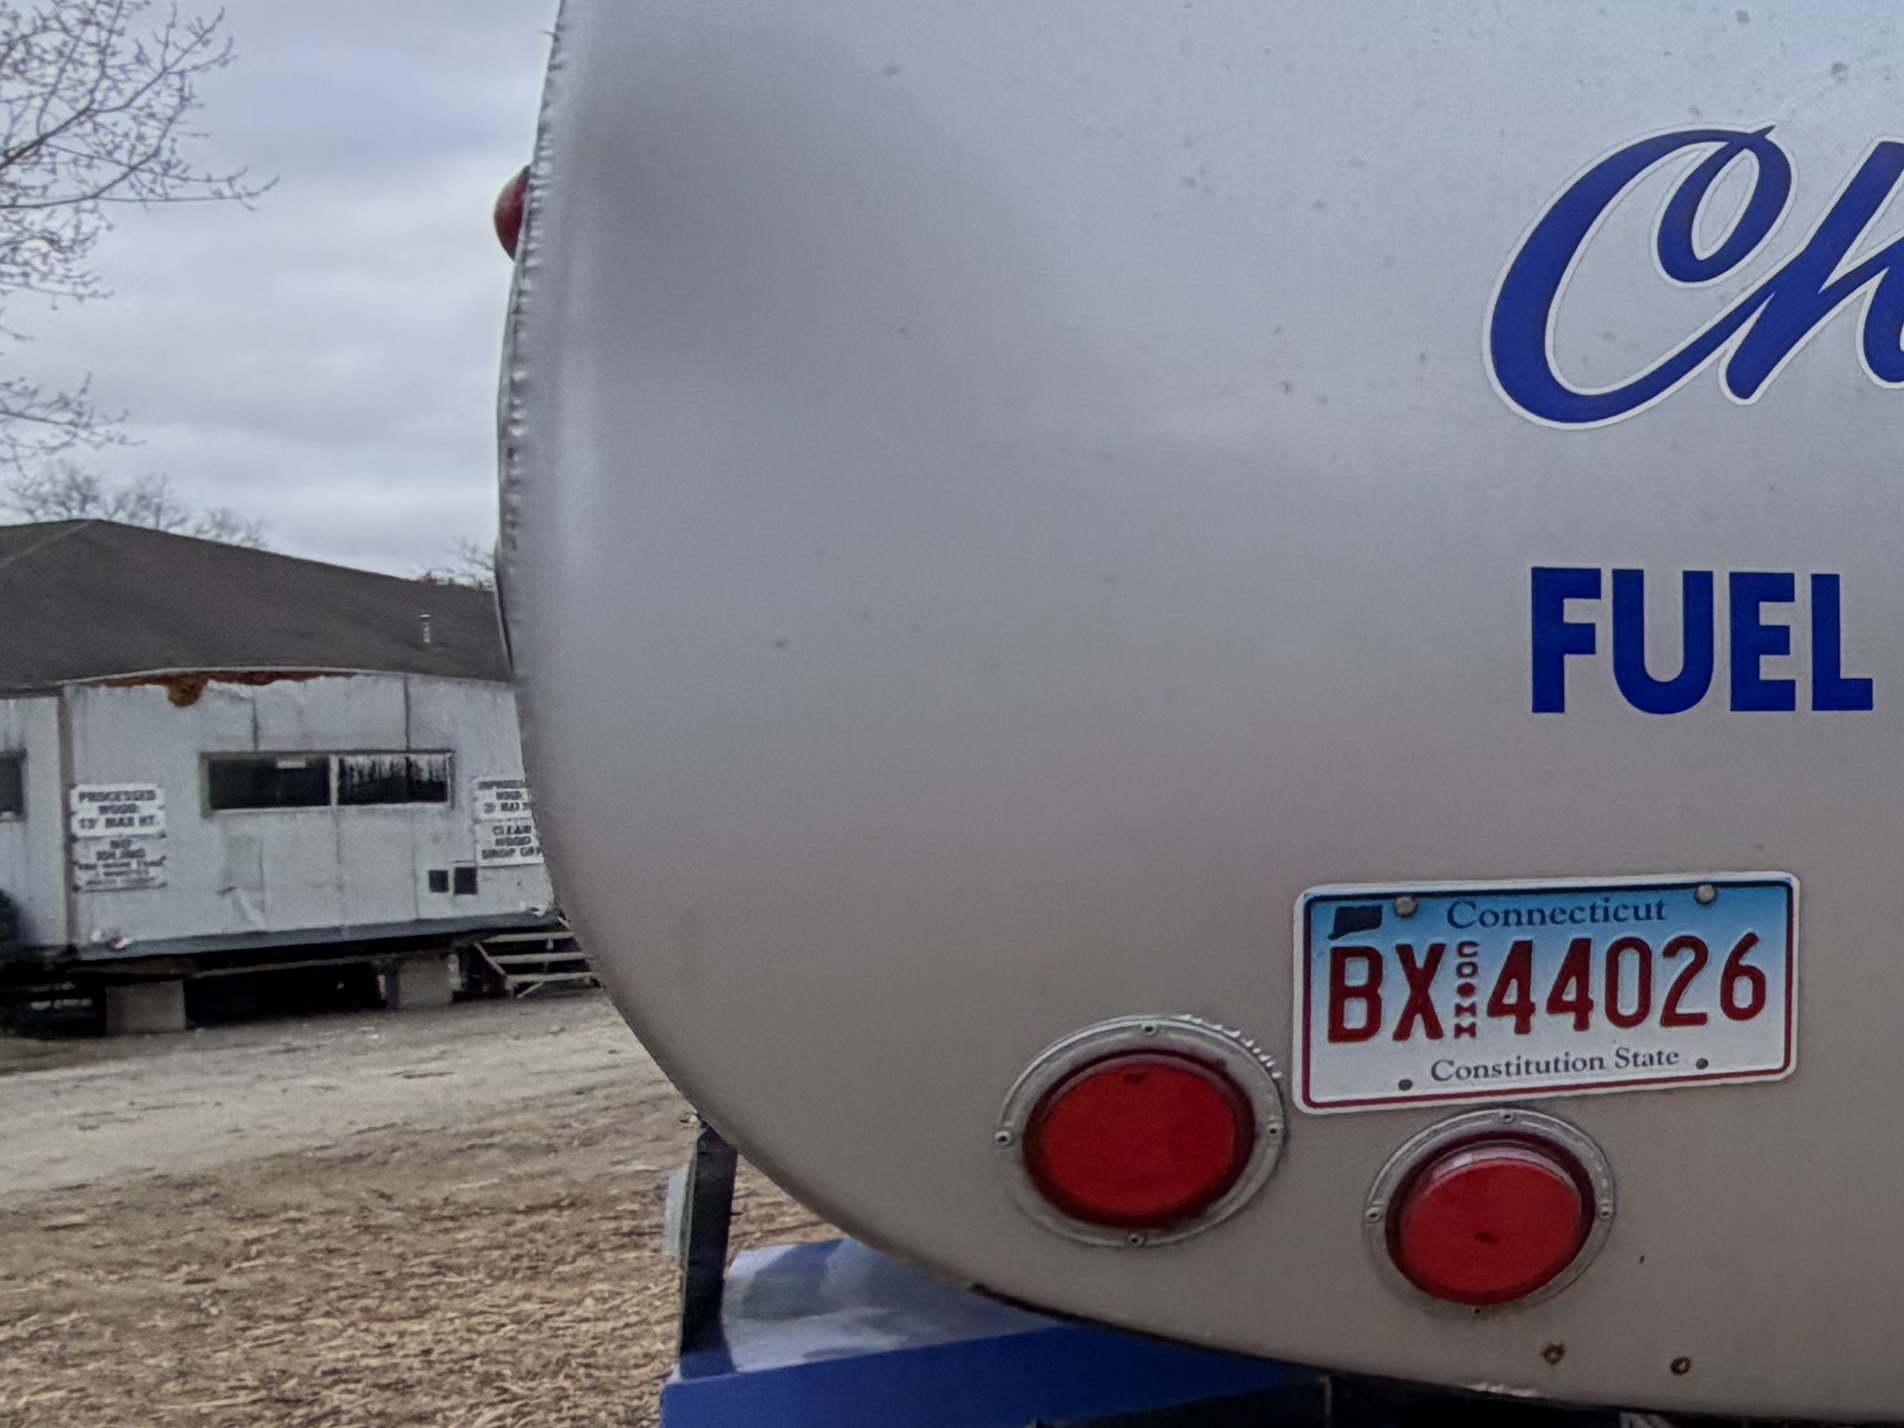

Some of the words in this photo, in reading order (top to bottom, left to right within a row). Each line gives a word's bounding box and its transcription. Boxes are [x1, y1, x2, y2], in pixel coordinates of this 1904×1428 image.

[1531, 566, 1874, 715] FUEL
[79, 790, 156, 803] PROCESSED
[1447, 897, 1667, 930] Connecticut
[1430, 1052, 1605, 1084] Constitution
[1614, 1046, 1680, 1071] State
